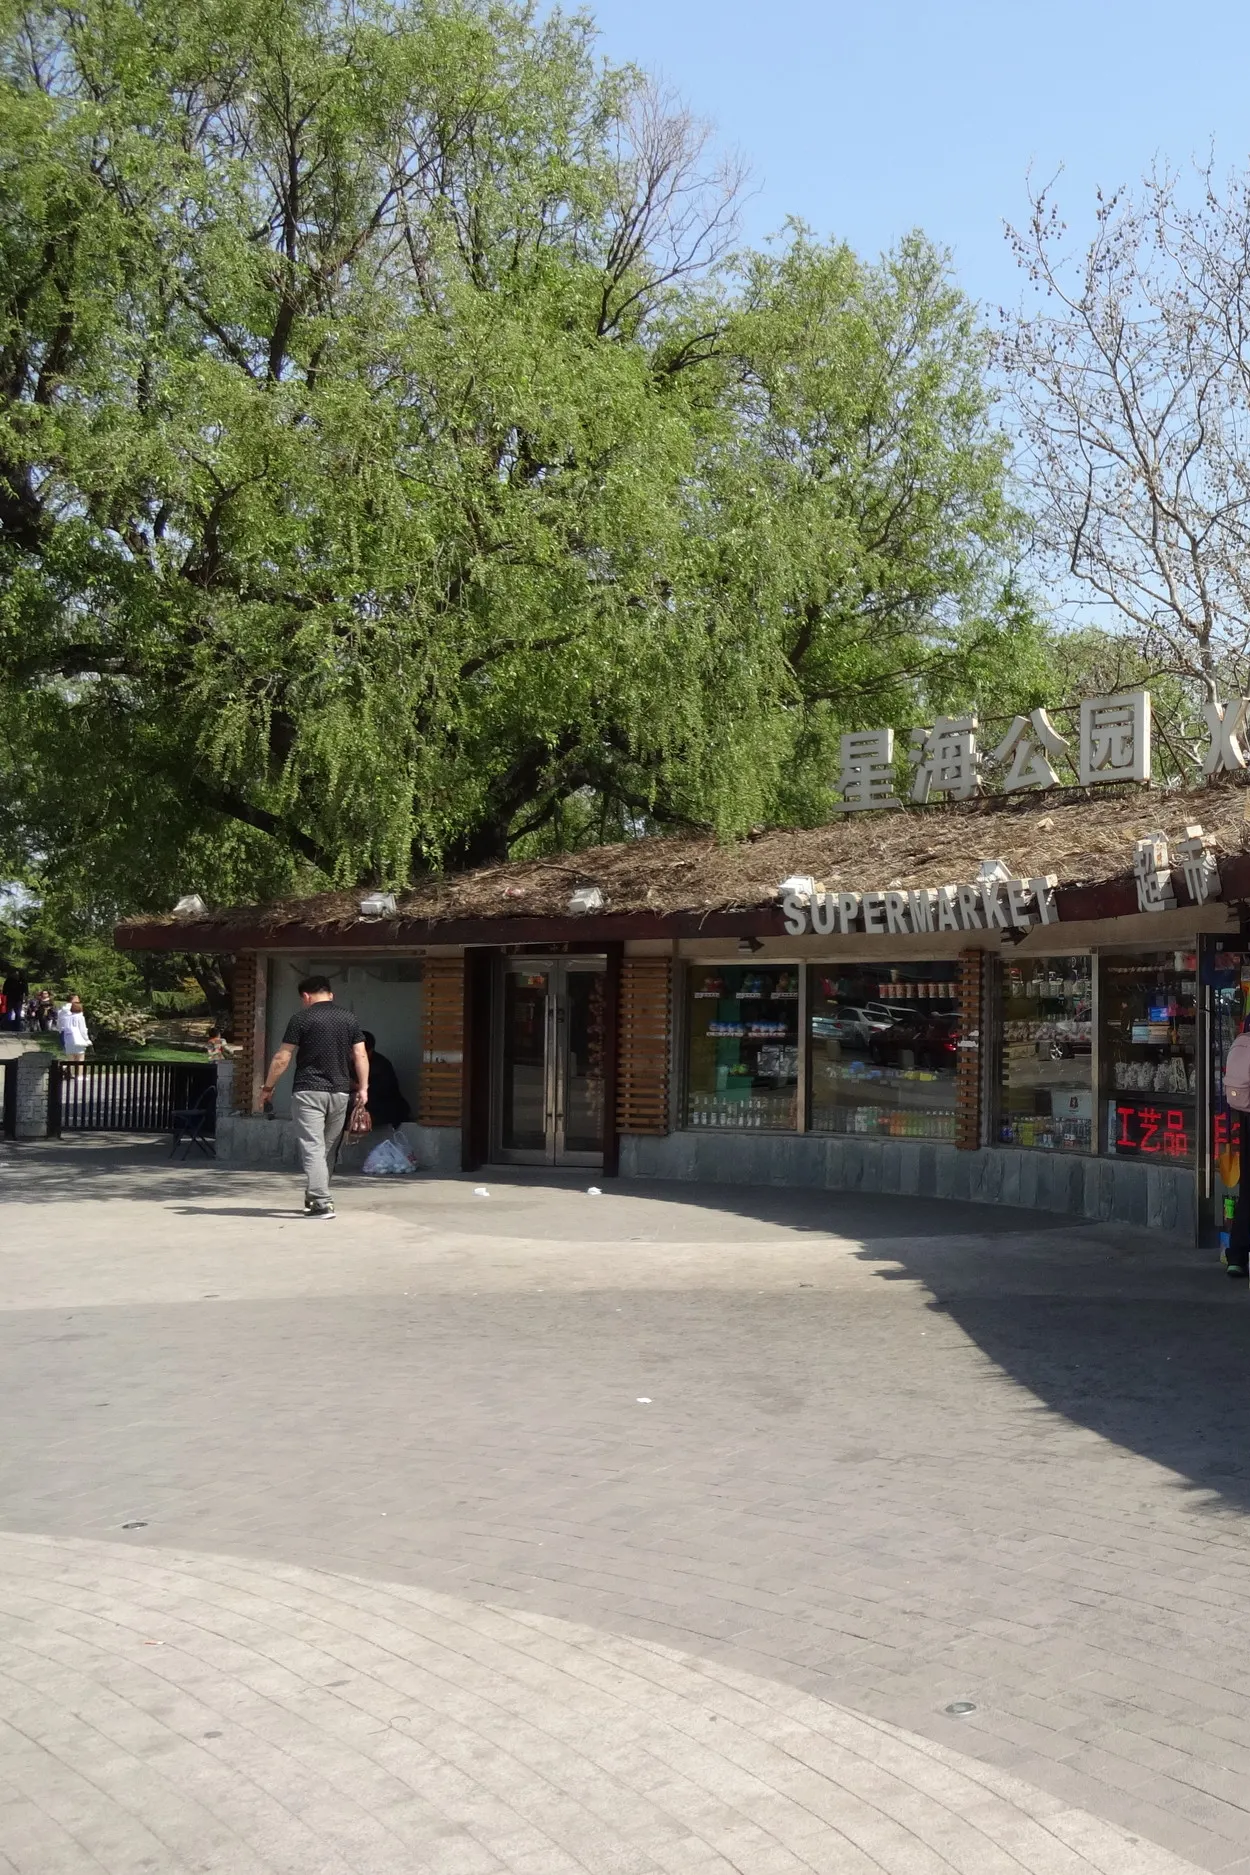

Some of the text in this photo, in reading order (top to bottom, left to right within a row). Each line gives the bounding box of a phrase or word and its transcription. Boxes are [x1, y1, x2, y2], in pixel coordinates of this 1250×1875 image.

[833, 691, 1151, 813] 星海公园
[783, 874, 1059, 936] SUPERMARKET
[1133, 825, 1222, 912] 超市
[1116, 1106, 1188, 1157] 工艺品
